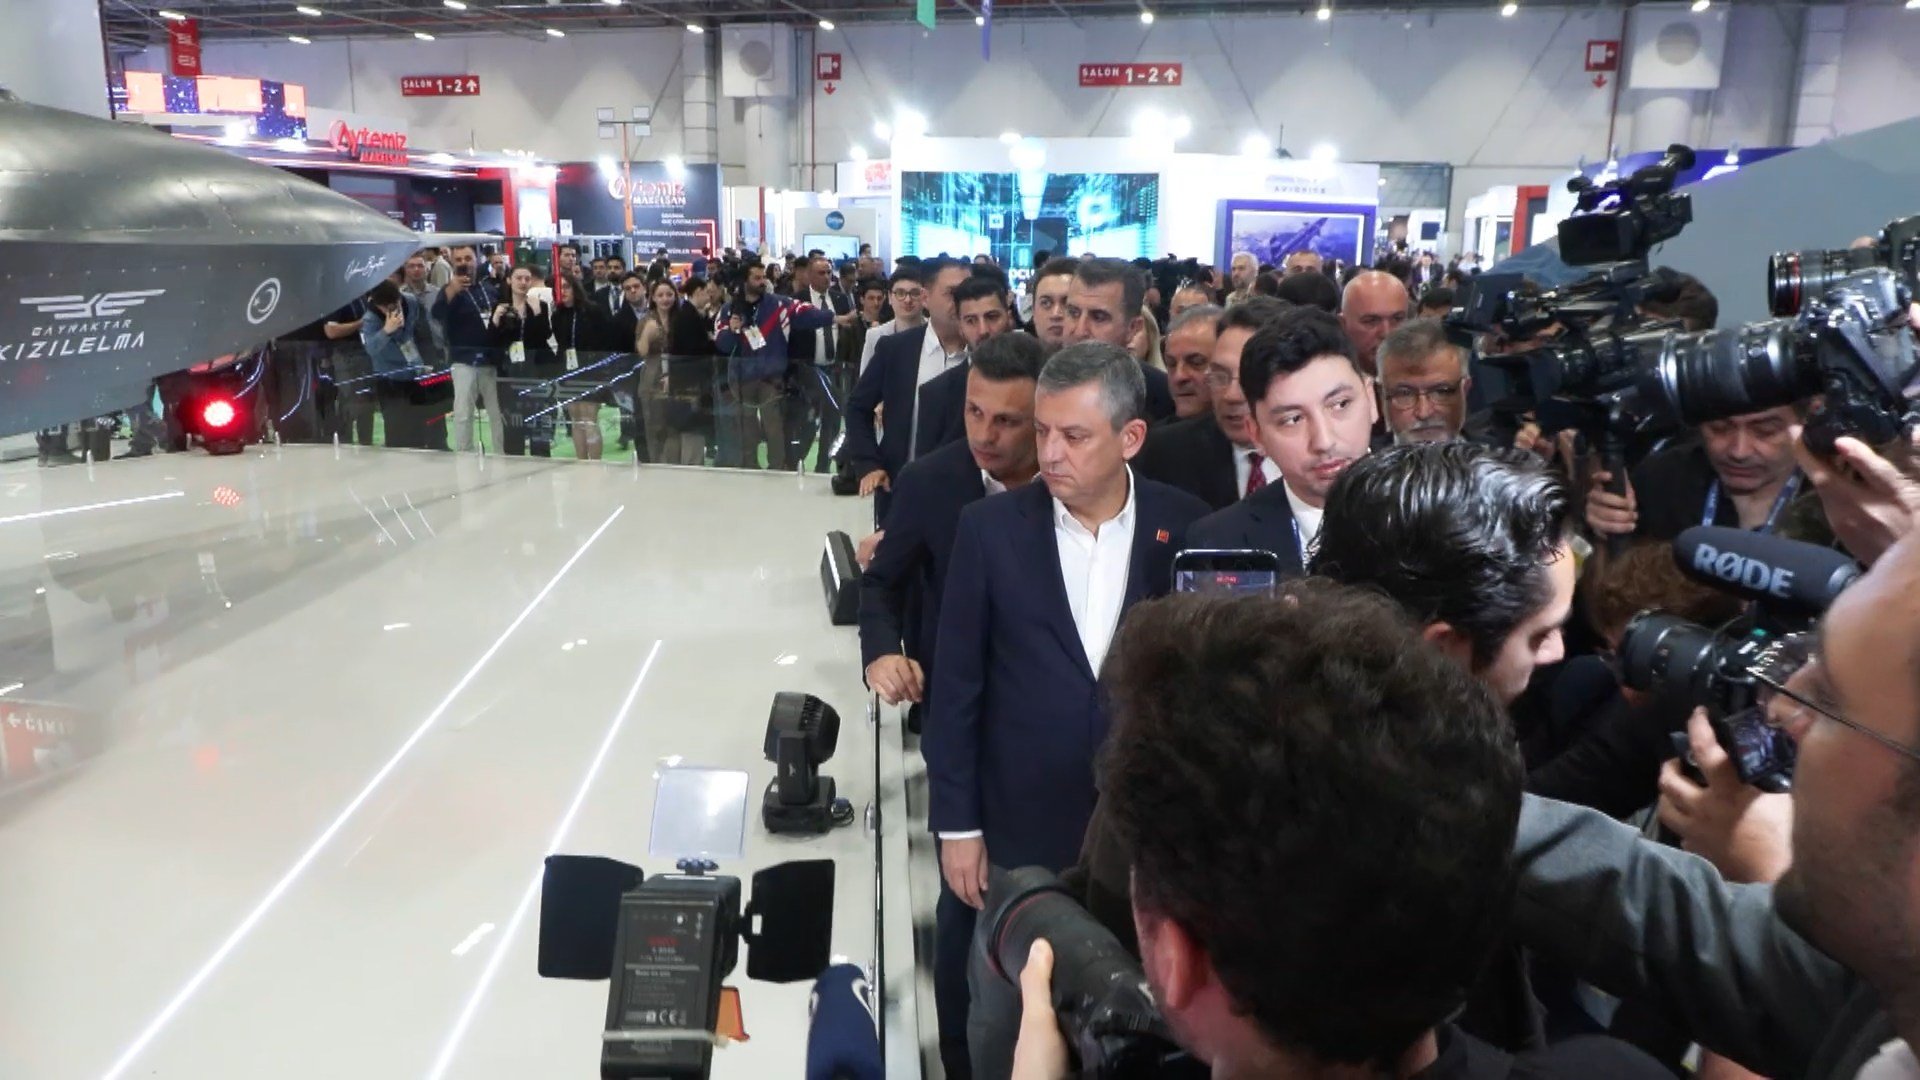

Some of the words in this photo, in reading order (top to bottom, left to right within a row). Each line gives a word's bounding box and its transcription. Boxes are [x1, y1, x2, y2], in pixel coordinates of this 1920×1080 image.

[1082, 67, 1120, 77] SALON
[403, 79, 432, 89] SALON
[1694, 543, 1795, 599] RØDE
